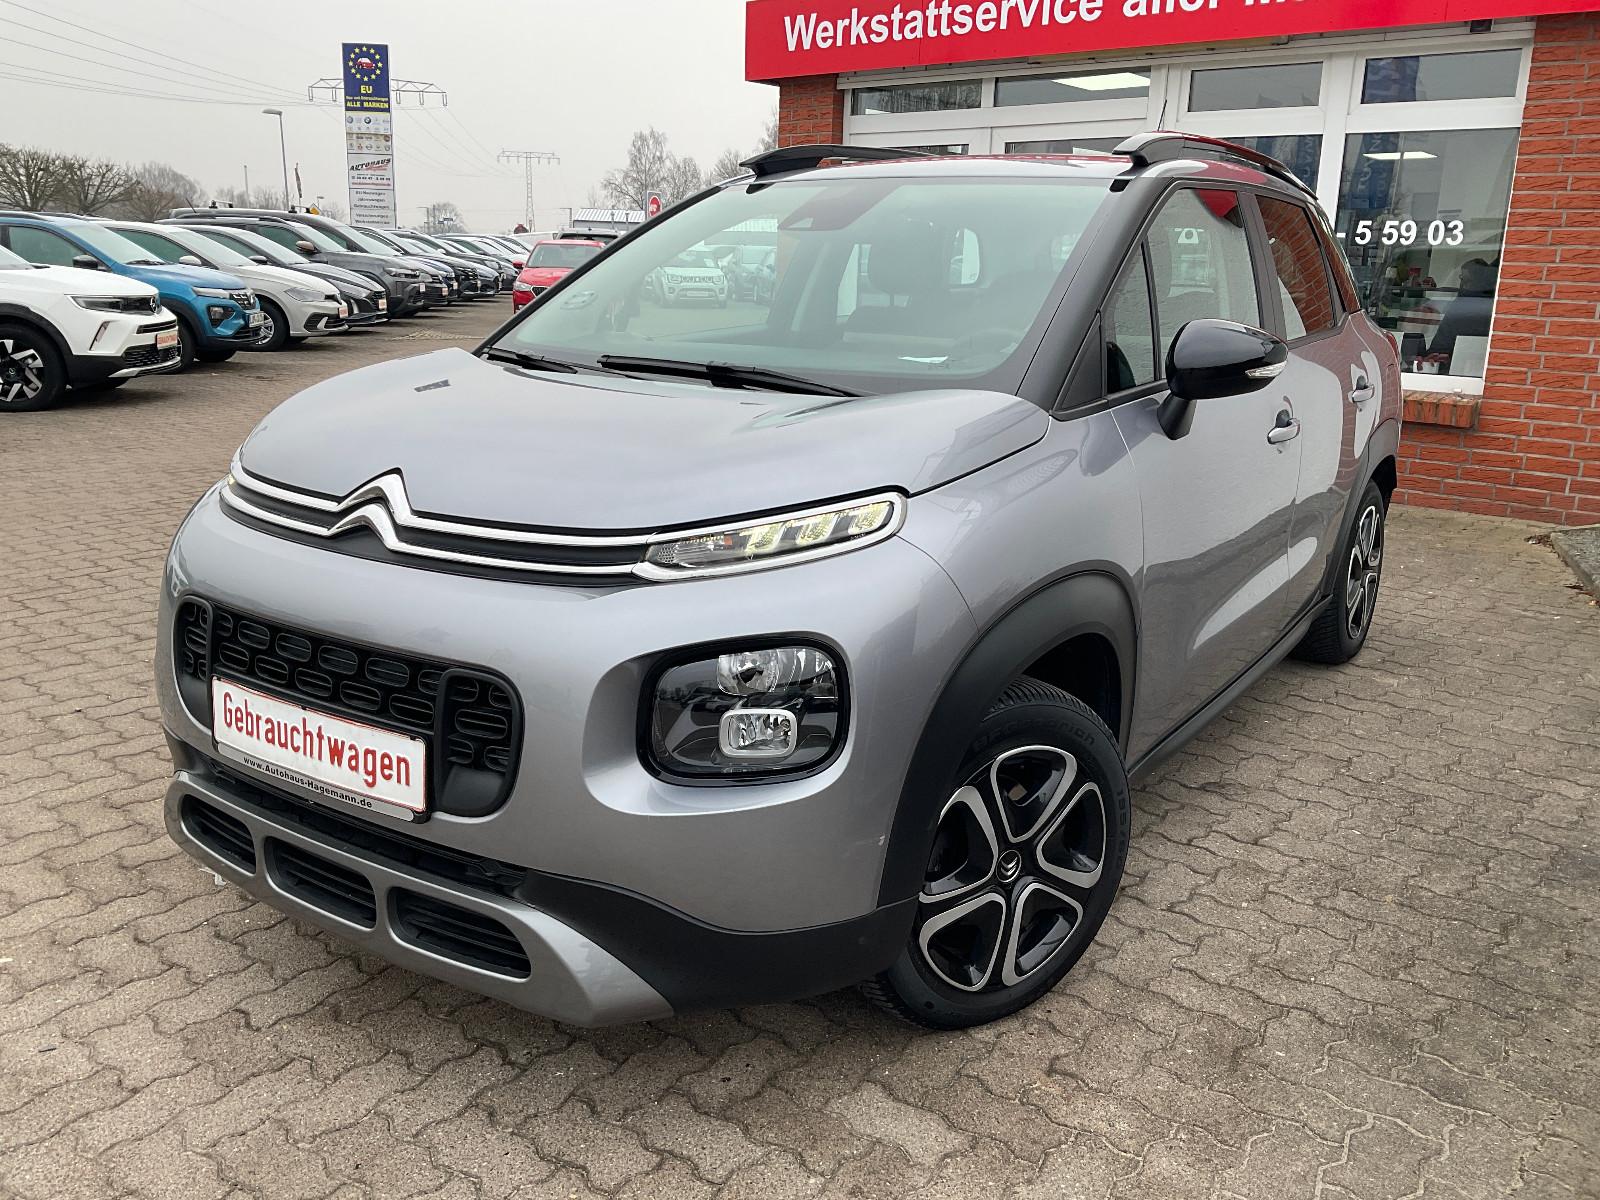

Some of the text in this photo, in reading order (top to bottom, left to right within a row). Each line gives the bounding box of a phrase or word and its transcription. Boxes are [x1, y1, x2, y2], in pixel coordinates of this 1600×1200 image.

[784, 0, 1104, 51] Werkstattservice
[361, 85, 372, 94] EU
[350, 158, 391, 171] AUTOHAUS
[1354, 220, 1372, 245] 5
[1382, 220, 1417, 246] 59
[1427, 220, 1464, 246] 03
[223, 691, 410, 788] Gebrauchtwagen
[243, 755, 373, 809] www.Autohaus-Hagemann.de
